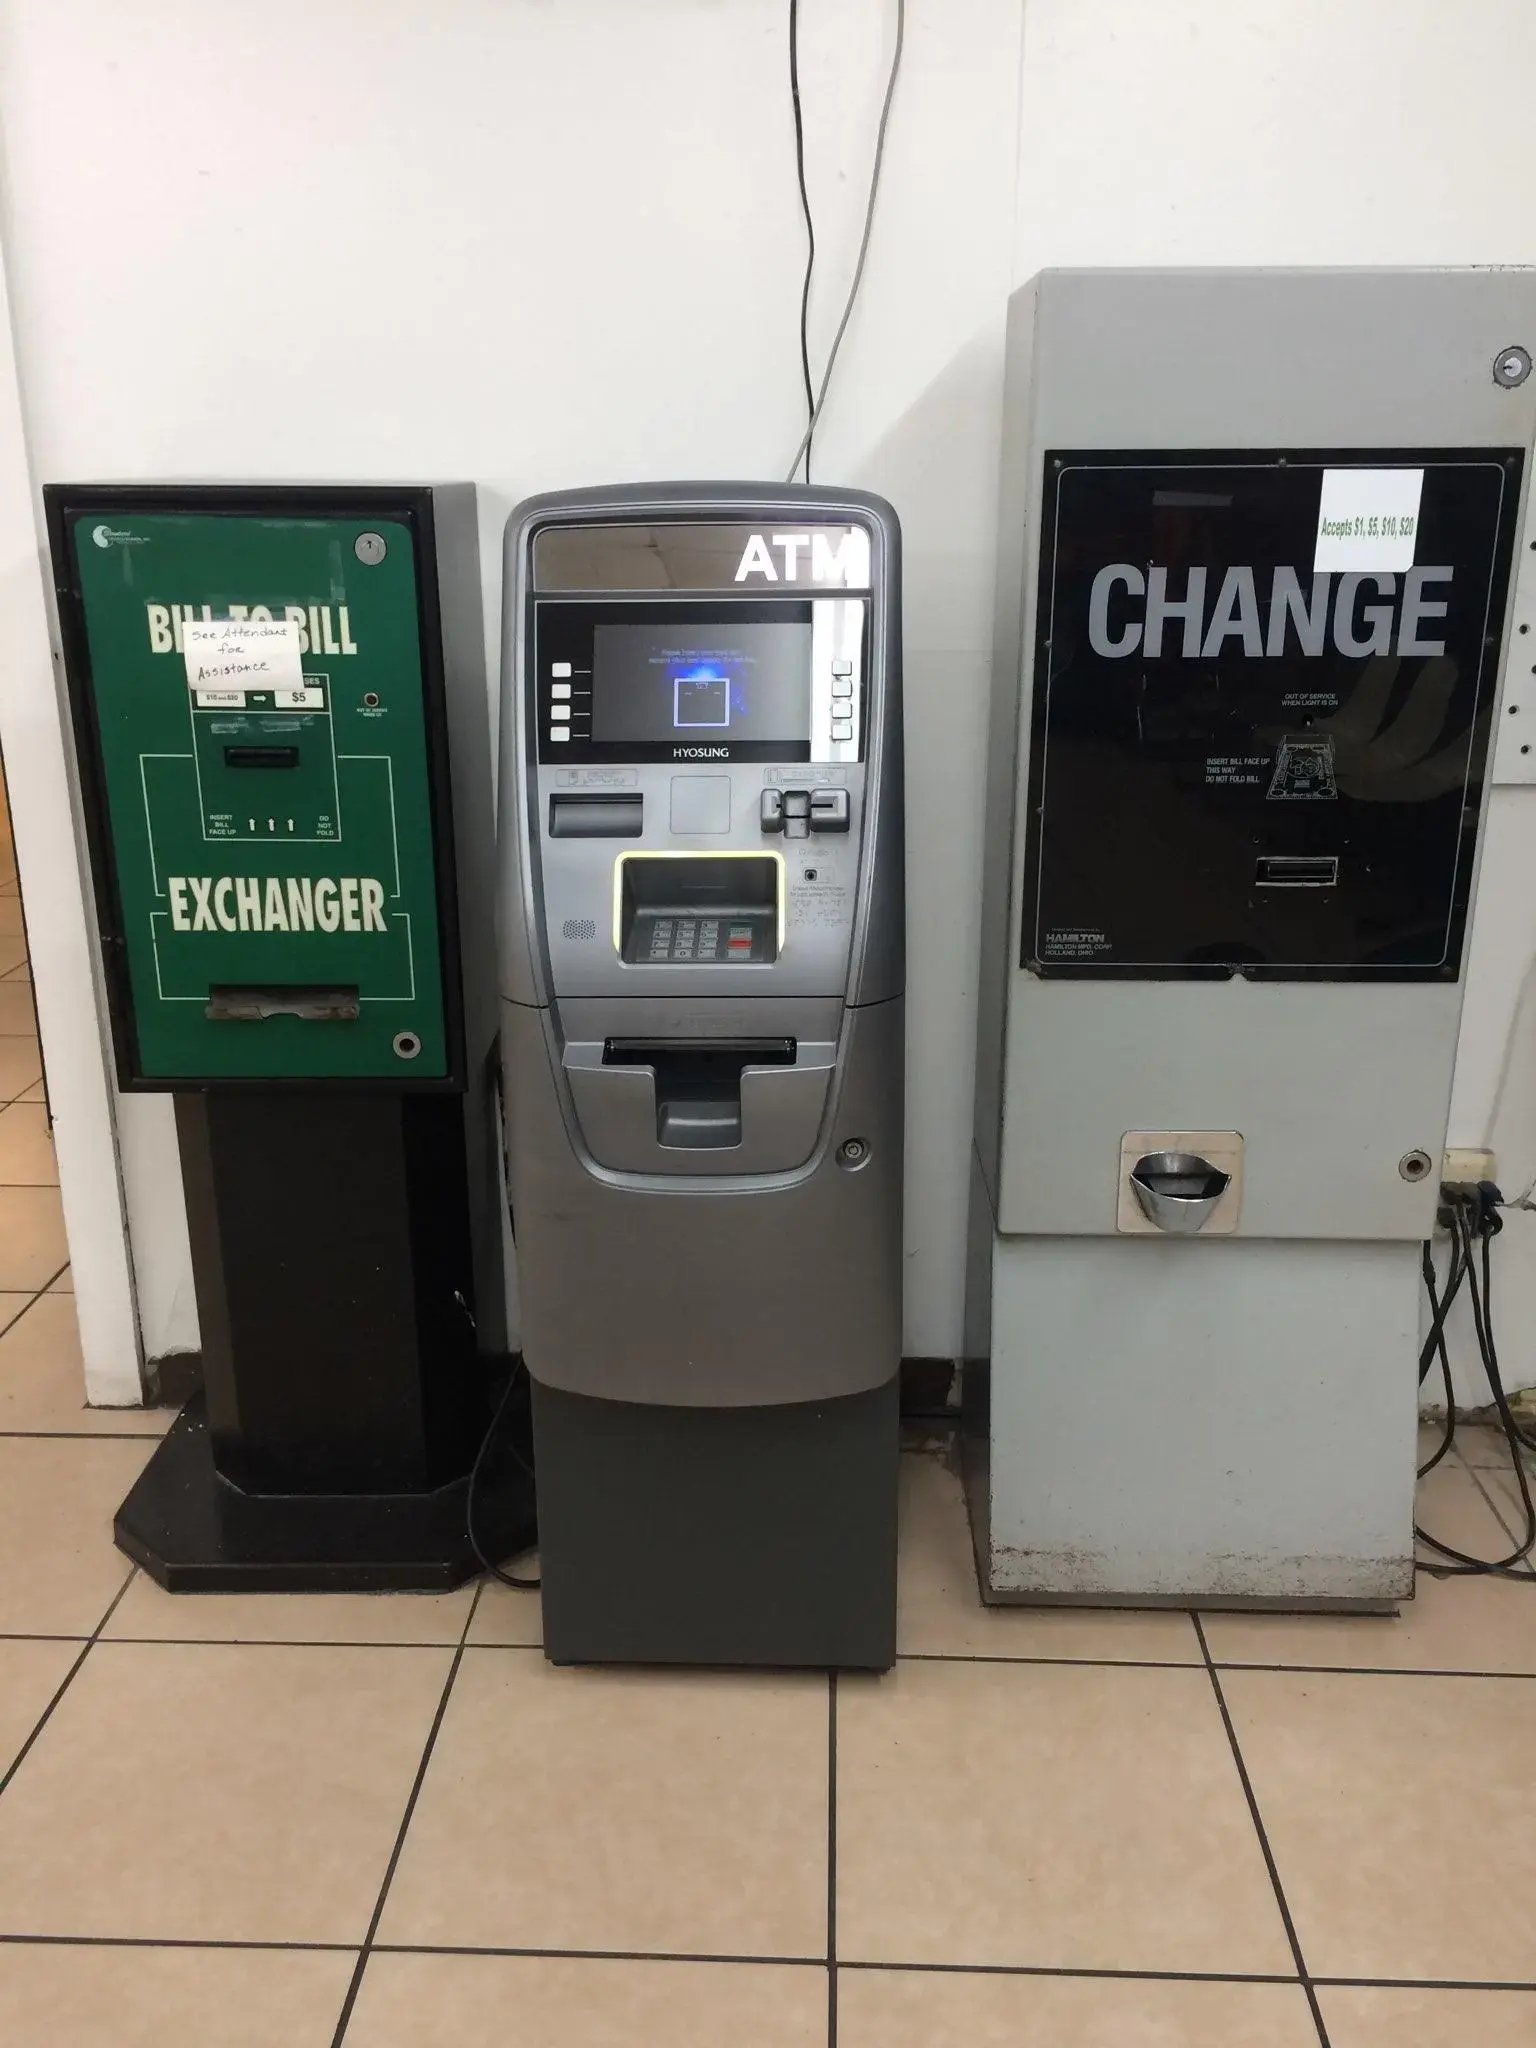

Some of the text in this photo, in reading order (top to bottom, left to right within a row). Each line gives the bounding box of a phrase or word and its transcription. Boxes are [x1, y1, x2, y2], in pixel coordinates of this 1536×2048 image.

[1321, 516, 1414, 540] Accepts $1, $5, $10, $20
[734, 533, 853, 582] ATM
[1088, 563, 1454, 658] CHANGE
[220, 625, 288, 639] Attendant
[198, 661, 270, 681] Assistance
[291, 691, 307, 703] $5
[673, 748, 730, 758] HYOSUNG
[1206, 758, 1229, 766] INSERT
[1244, 758, 1261, 766] FACE
[1206, 766, 1237, 774] THIS WAY
[1229, 775, 1246, 783] FOLD
[168, 876, 388, 933] EXCHANGER
[1046, 934, 1105, 943] HAMILTON
